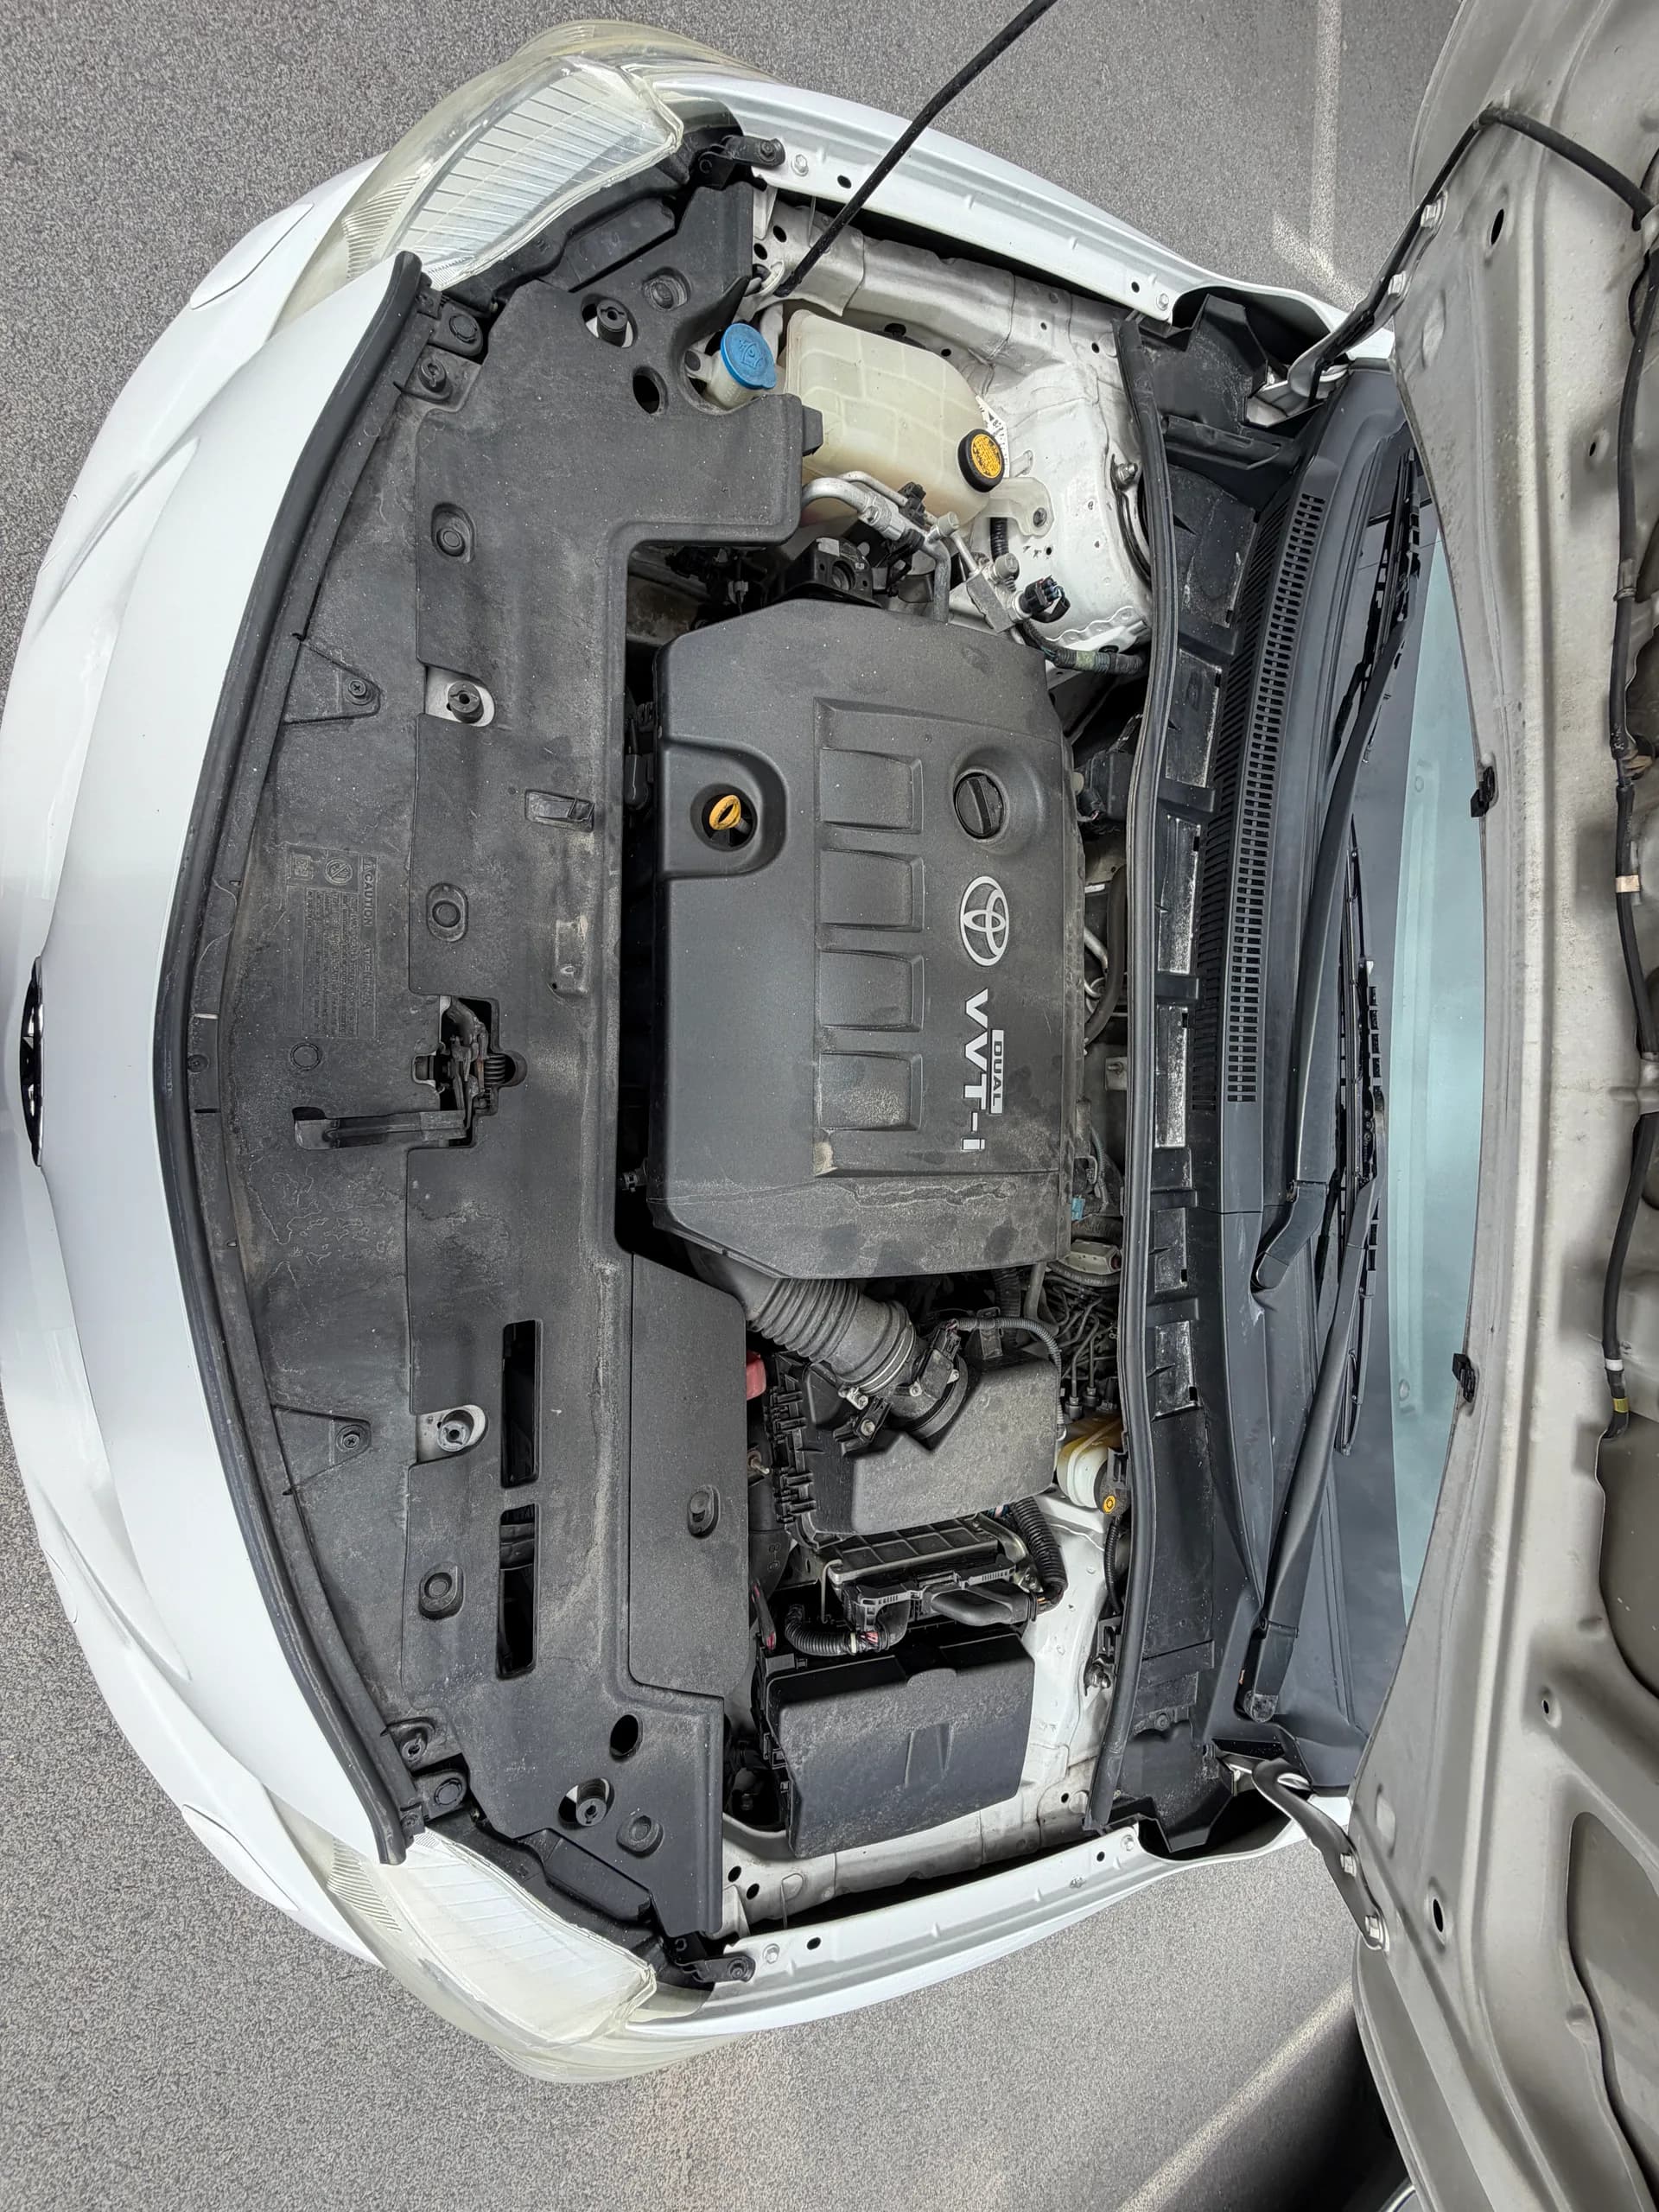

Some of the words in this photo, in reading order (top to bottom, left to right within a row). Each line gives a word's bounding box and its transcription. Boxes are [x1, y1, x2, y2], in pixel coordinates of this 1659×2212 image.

[363, 873, 374, 927] CAUTION
[963, 988, 988, 1151] VVT-i
[993, 1040, 1002, 1107] DUAL
